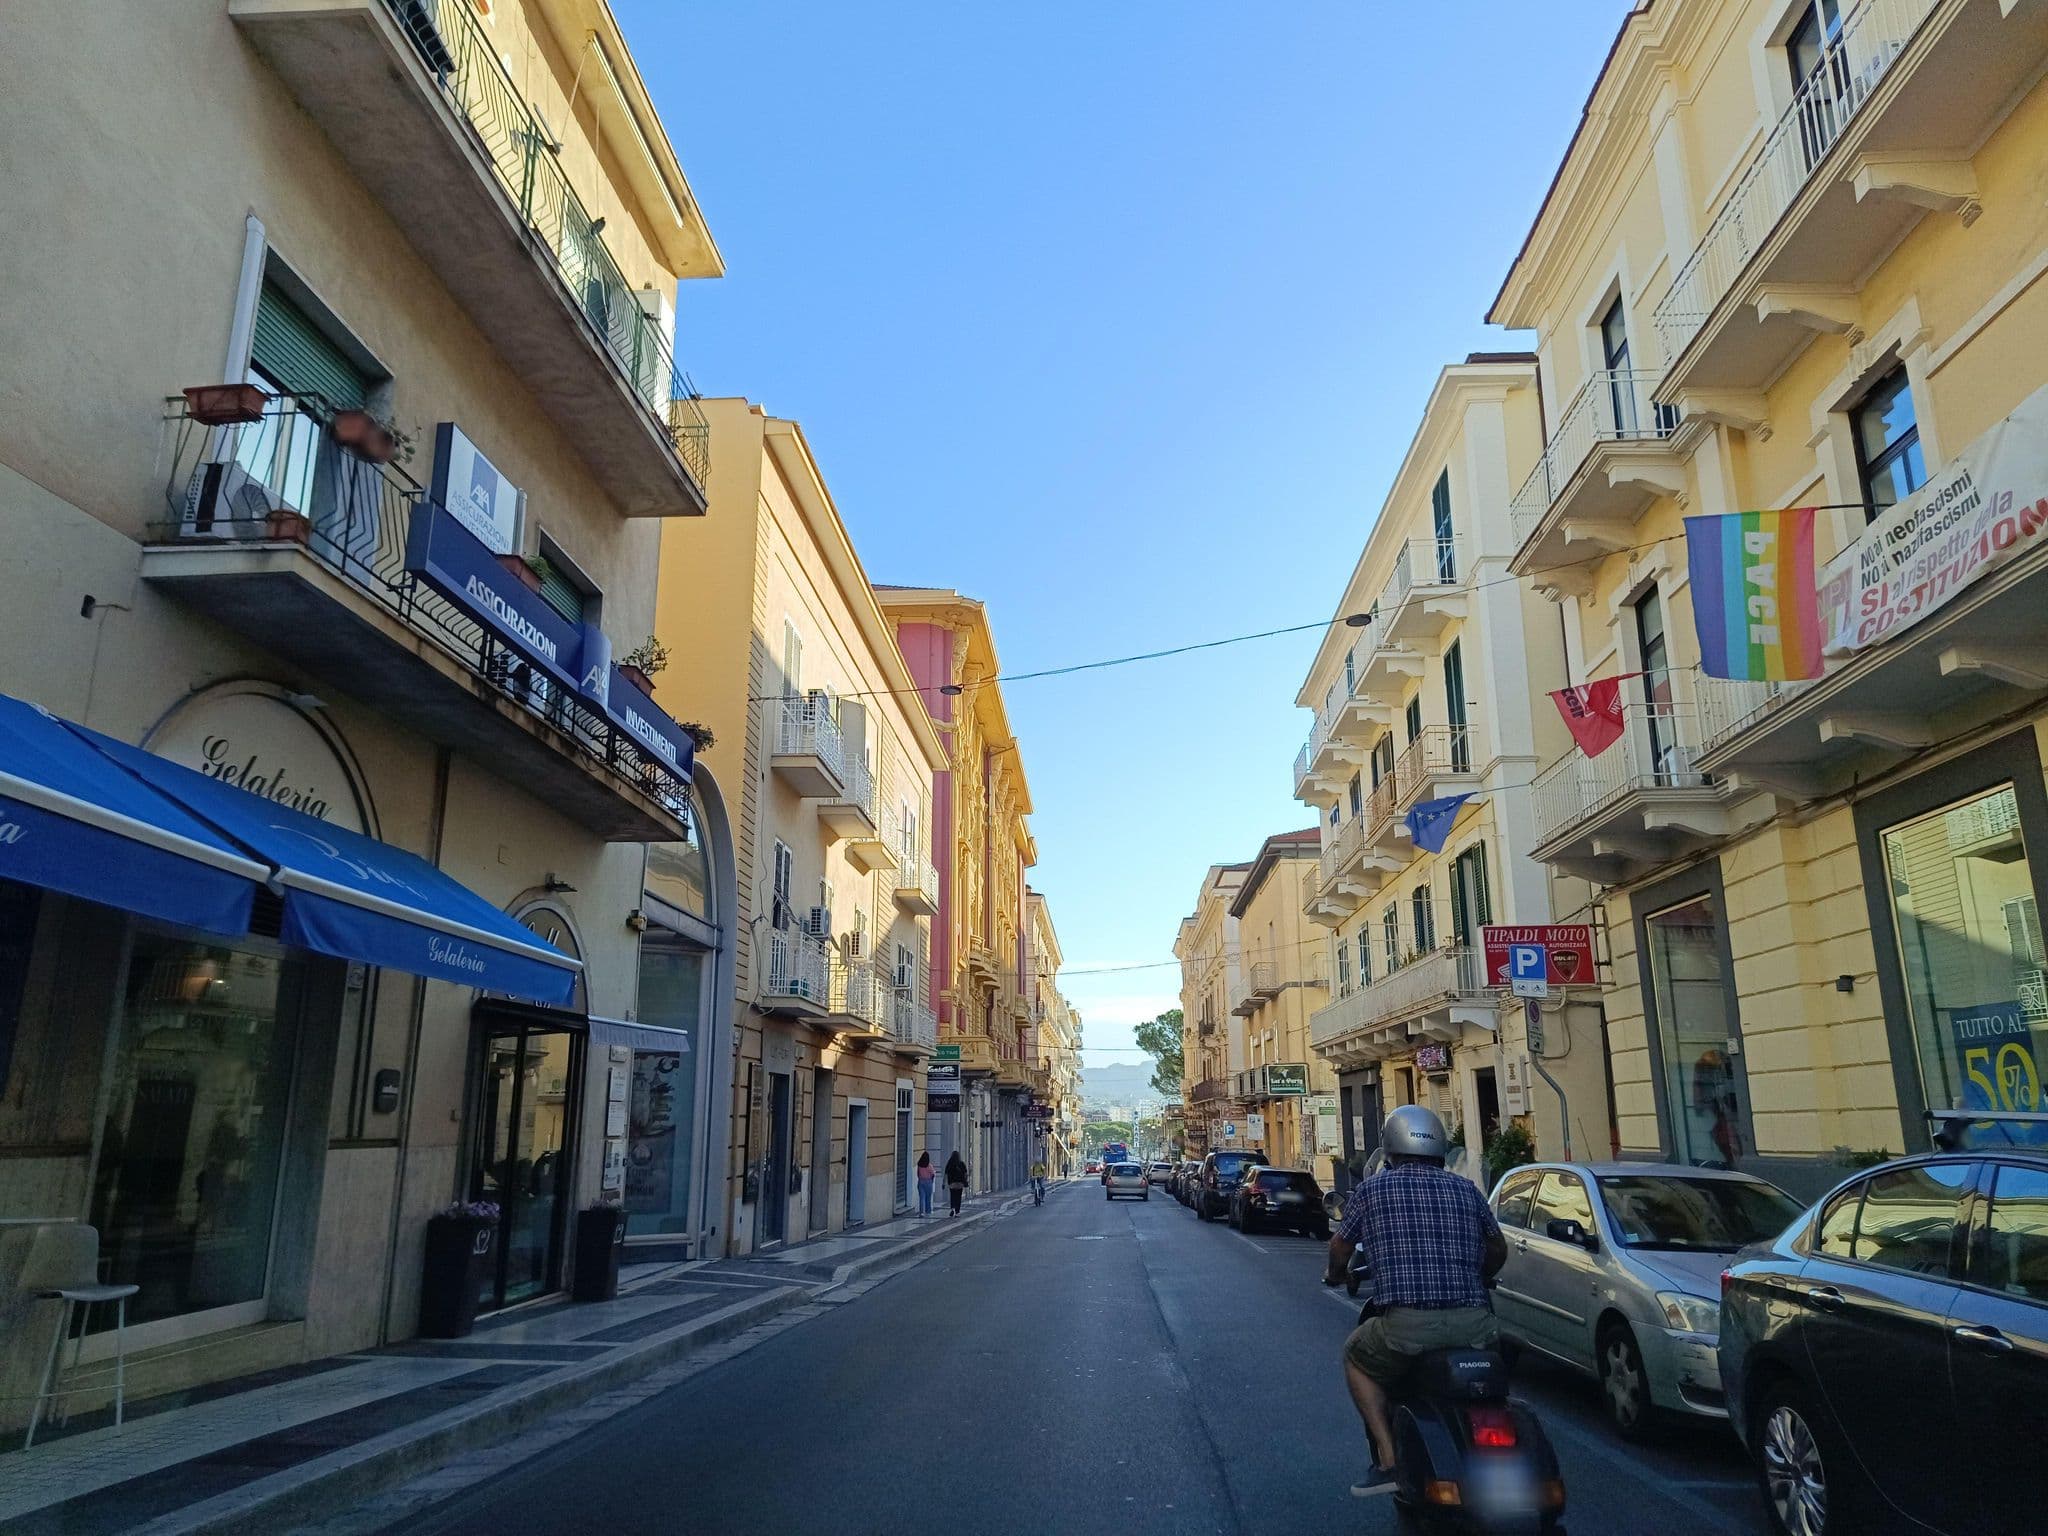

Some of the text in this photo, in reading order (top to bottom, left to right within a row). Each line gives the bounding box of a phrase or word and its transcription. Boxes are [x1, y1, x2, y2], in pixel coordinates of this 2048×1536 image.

[1886, 468, 1973, 547] neofascismi
[1892, 487, 1982, 566] nazifascismi
[1906, 527, 1970, 589] rispetto
[1973, 490, 2014, 539] della
[465, 574, 557, 662] ASSICURAZIONI
[581, 664, 608, 694] AXA
[626, 705, 677, 760] INVESTIMENTI
[202, 735, 332, 820] Gelateria
[428, 936, 486, 973] Gelateria
[1485, 928, 1586, 942] TIPALDI MOTO
[1516, 948, 1538, 975] P
[1956, 1013, 2026, 1038] TUTTO AL
[1226, 1125, 1234, 1134] P
